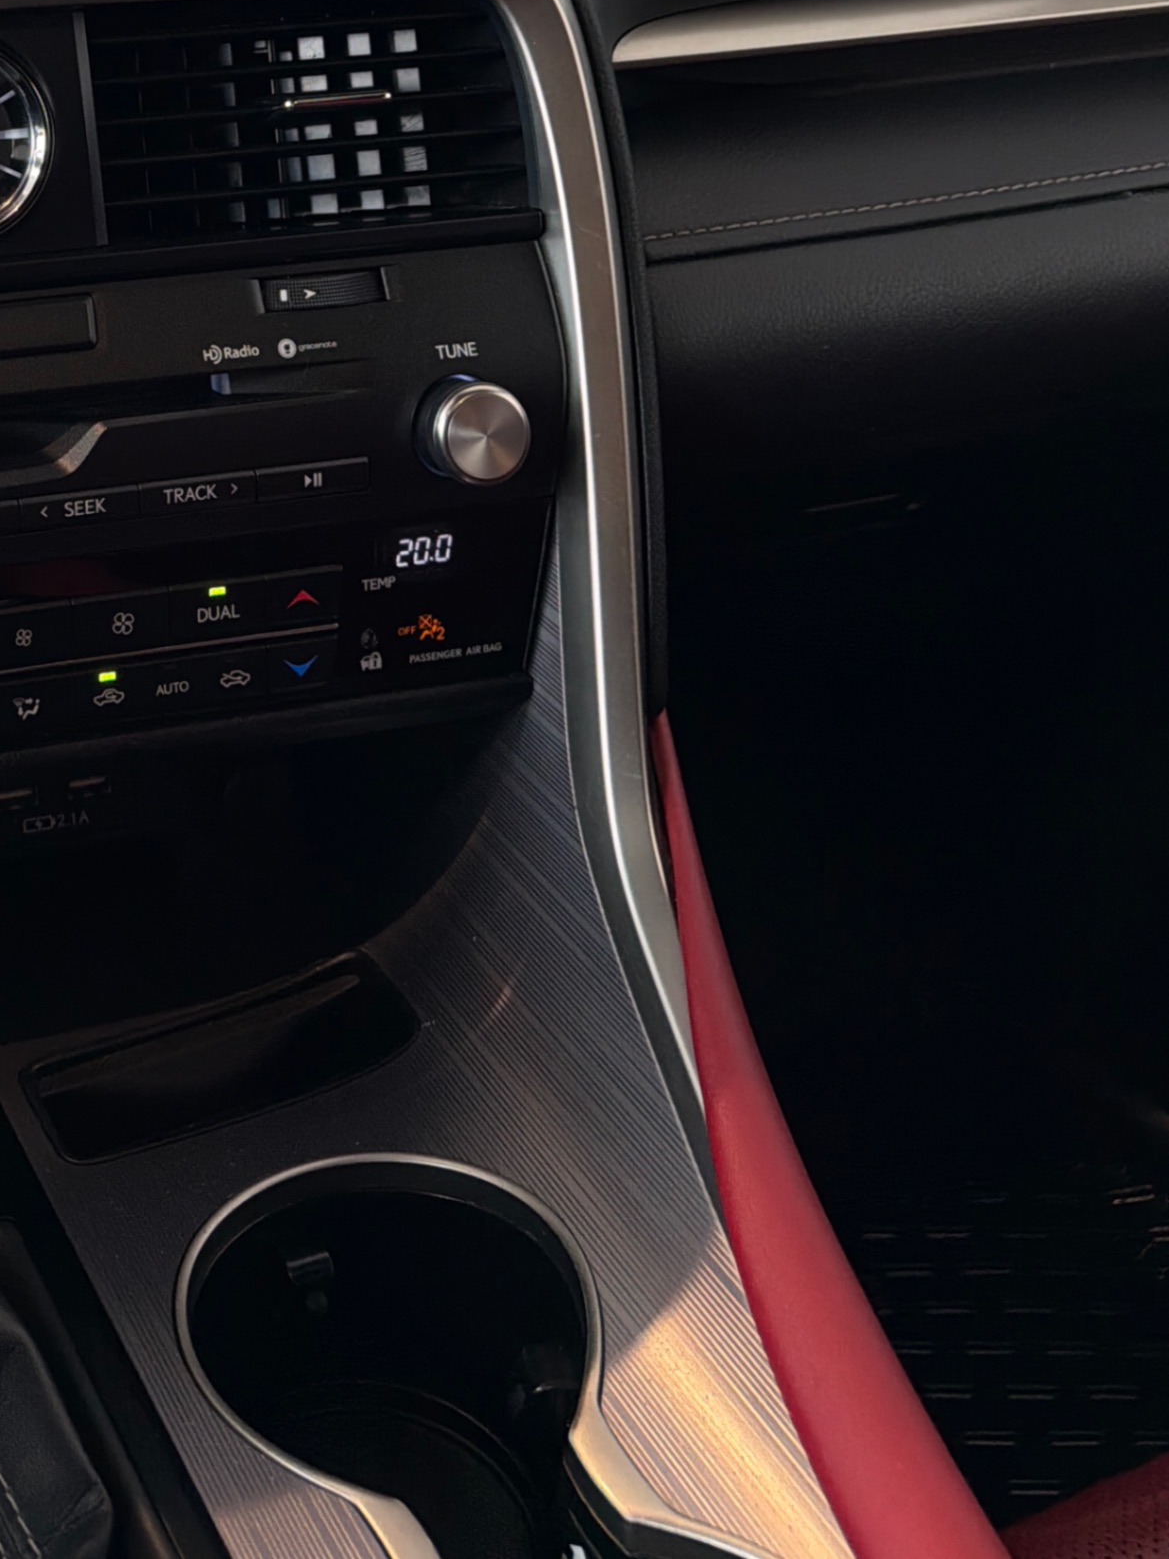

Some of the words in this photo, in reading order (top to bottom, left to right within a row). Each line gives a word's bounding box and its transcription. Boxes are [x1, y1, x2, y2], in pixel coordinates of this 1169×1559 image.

[223, 344, 260, 359] Radio
[434, 341, 479, 360] TUNE
[163, 484, 218, 505] TRACK
[63, 497, 107, 518] SEEK
[395, 533, 453, 568] 20.0
[361, 575, 396, 591] TEMP
[197, 603, 240, 624] DUAL
[397, 625, 416, 636] OFF
[409, 648, 462, 664] PASSENGER
[466, 645, 482, 656] AIR
[483, 642, 503, 654] BAG
[155, 680, 190, 697] AUTO
[56, 810, 90, 828] 2.1A
